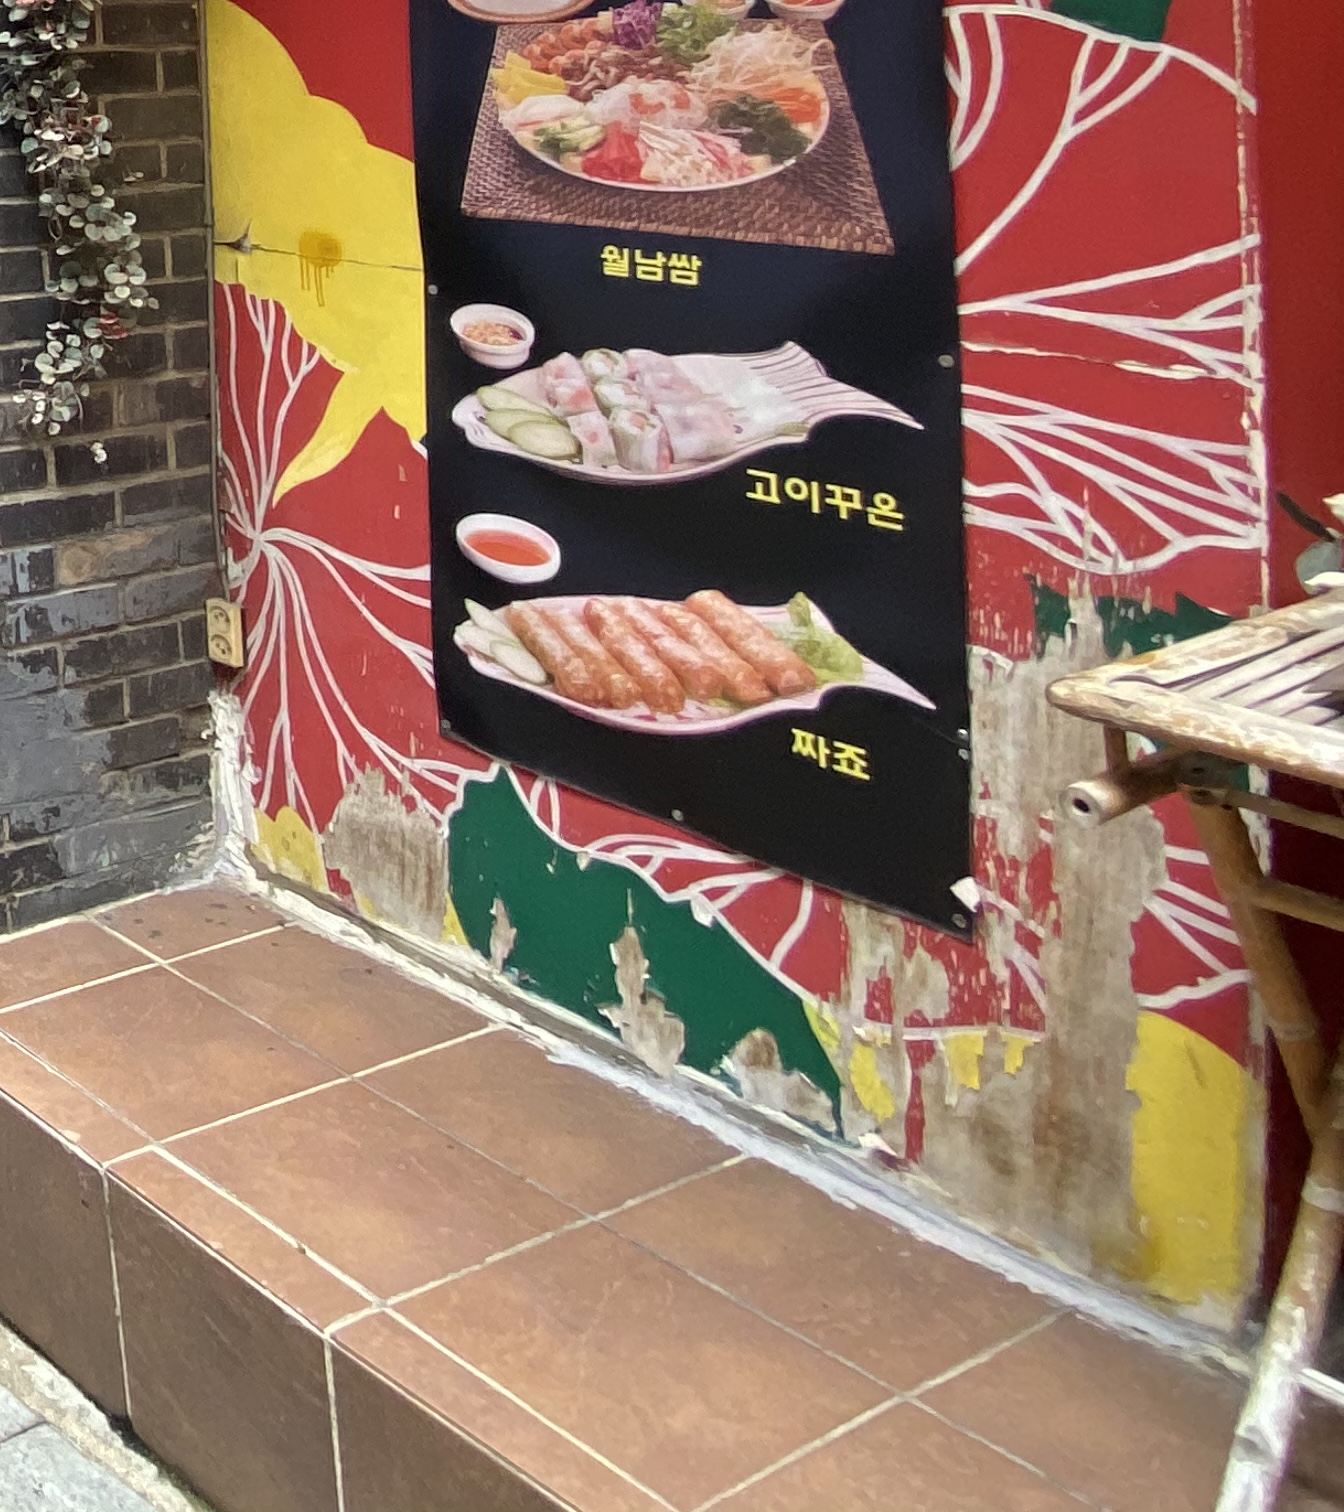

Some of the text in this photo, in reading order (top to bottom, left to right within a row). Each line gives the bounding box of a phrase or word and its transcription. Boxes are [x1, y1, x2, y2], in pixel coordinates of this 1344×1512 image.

[600, 244, 702, 286] 월남쌈
[745, 468, 905, 531] 고이꾸온
[791, 727, 871, 781] 짜죠
